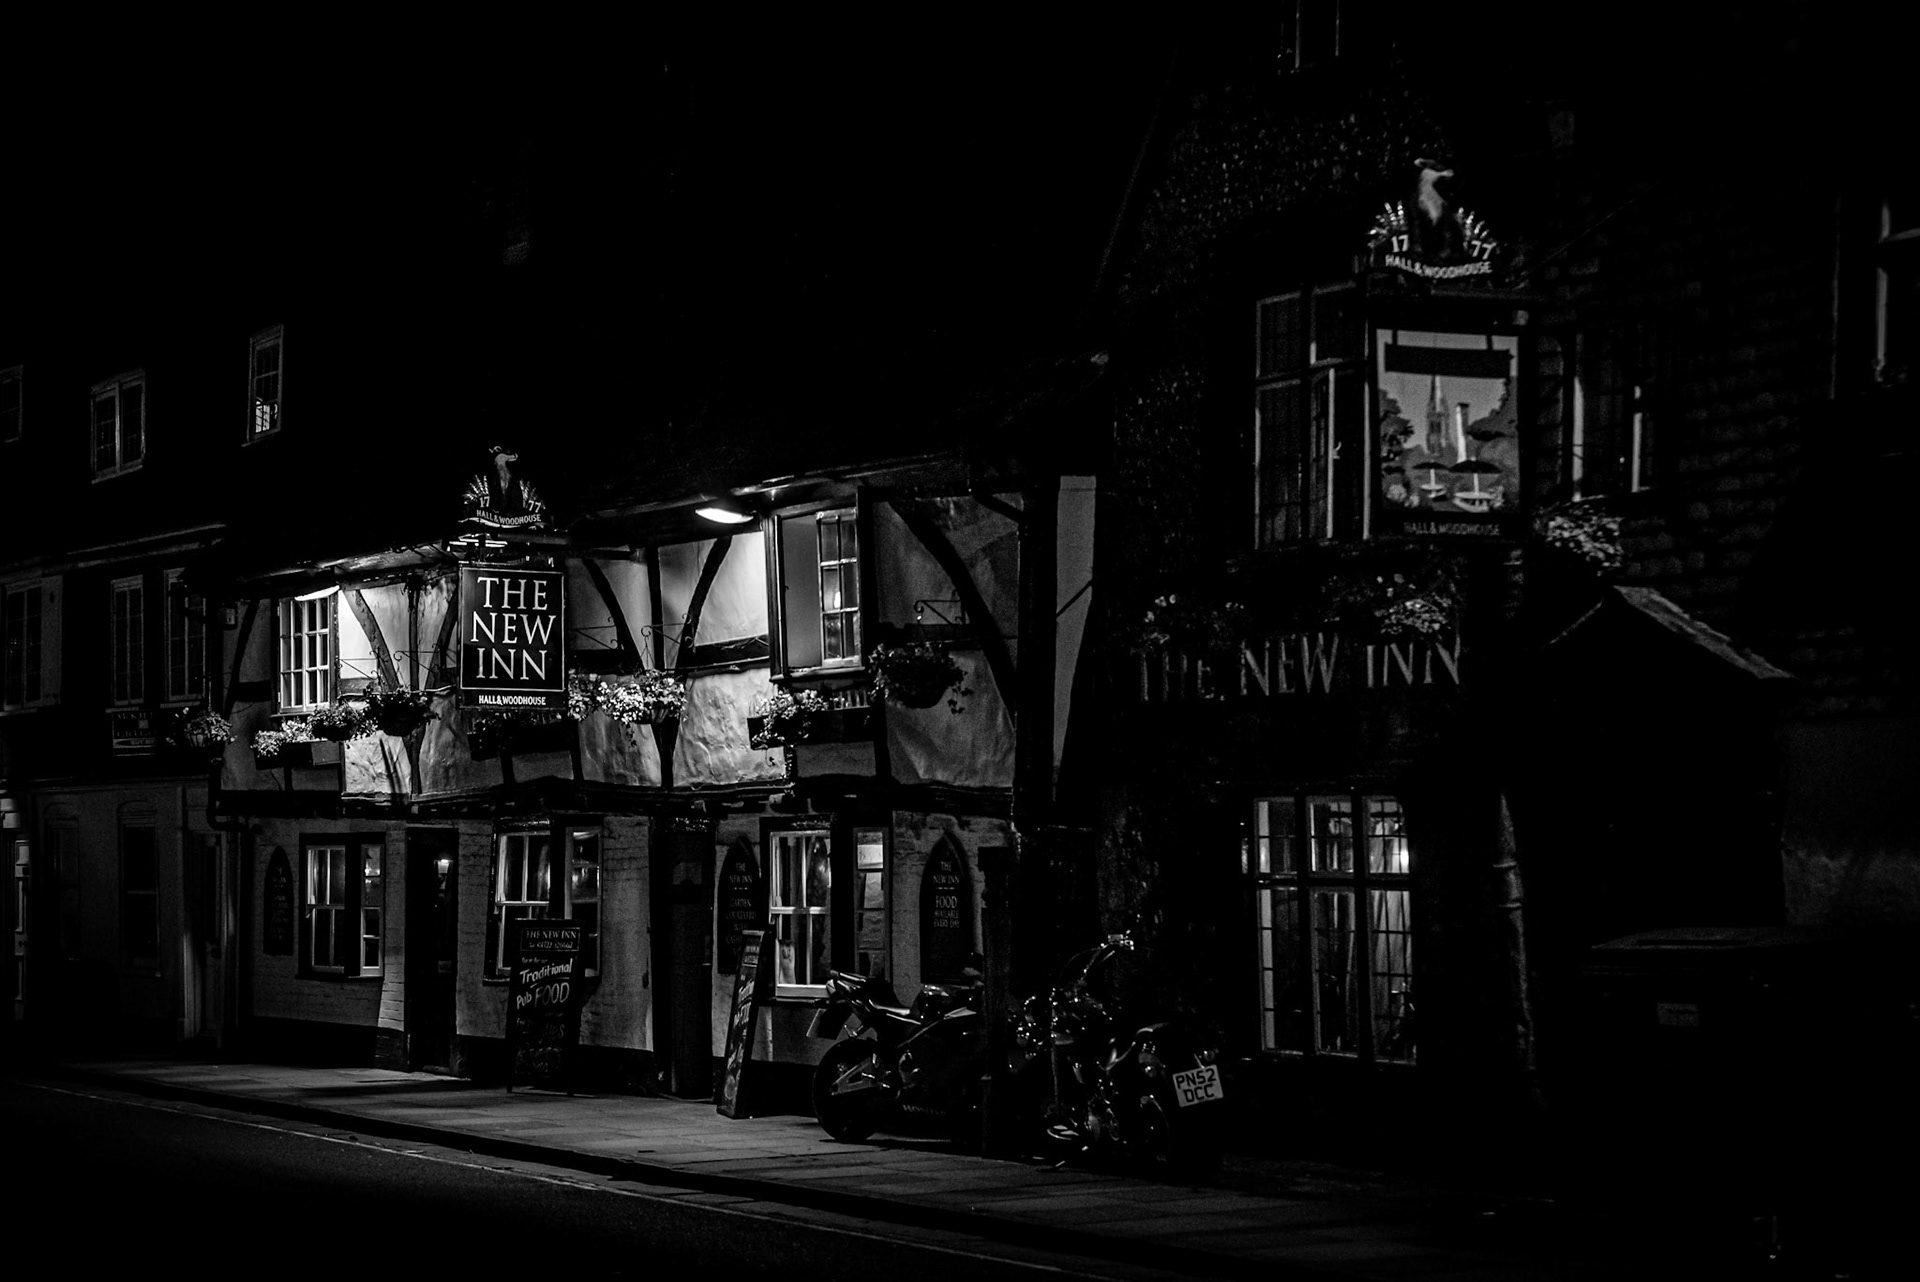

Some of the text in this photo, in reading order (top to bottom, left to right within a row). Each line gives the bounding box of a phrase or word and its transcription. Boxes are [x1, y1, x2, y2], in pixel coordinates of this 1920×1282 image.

[1391, 234, 1497, 260] 17 77
[479, 496, 542, 513] 17 77
[477, 576, 548, 611] THE
[470, 611, 556, 645] NEW
[476, 647, 548, 681] INN
[1131, 632, 1461, 700] THE NEW INN
[935, 895, 958, 909] FOOD
[526, 930, 577, 939] THE NEW INN
[519, 957, 573, 984] Traditional
[516, 981, 570, 1010] Pub FOOD
[1176, 1068, 1216, 1089] PN52
[1184, 1083, 1214, 1102] DCC
